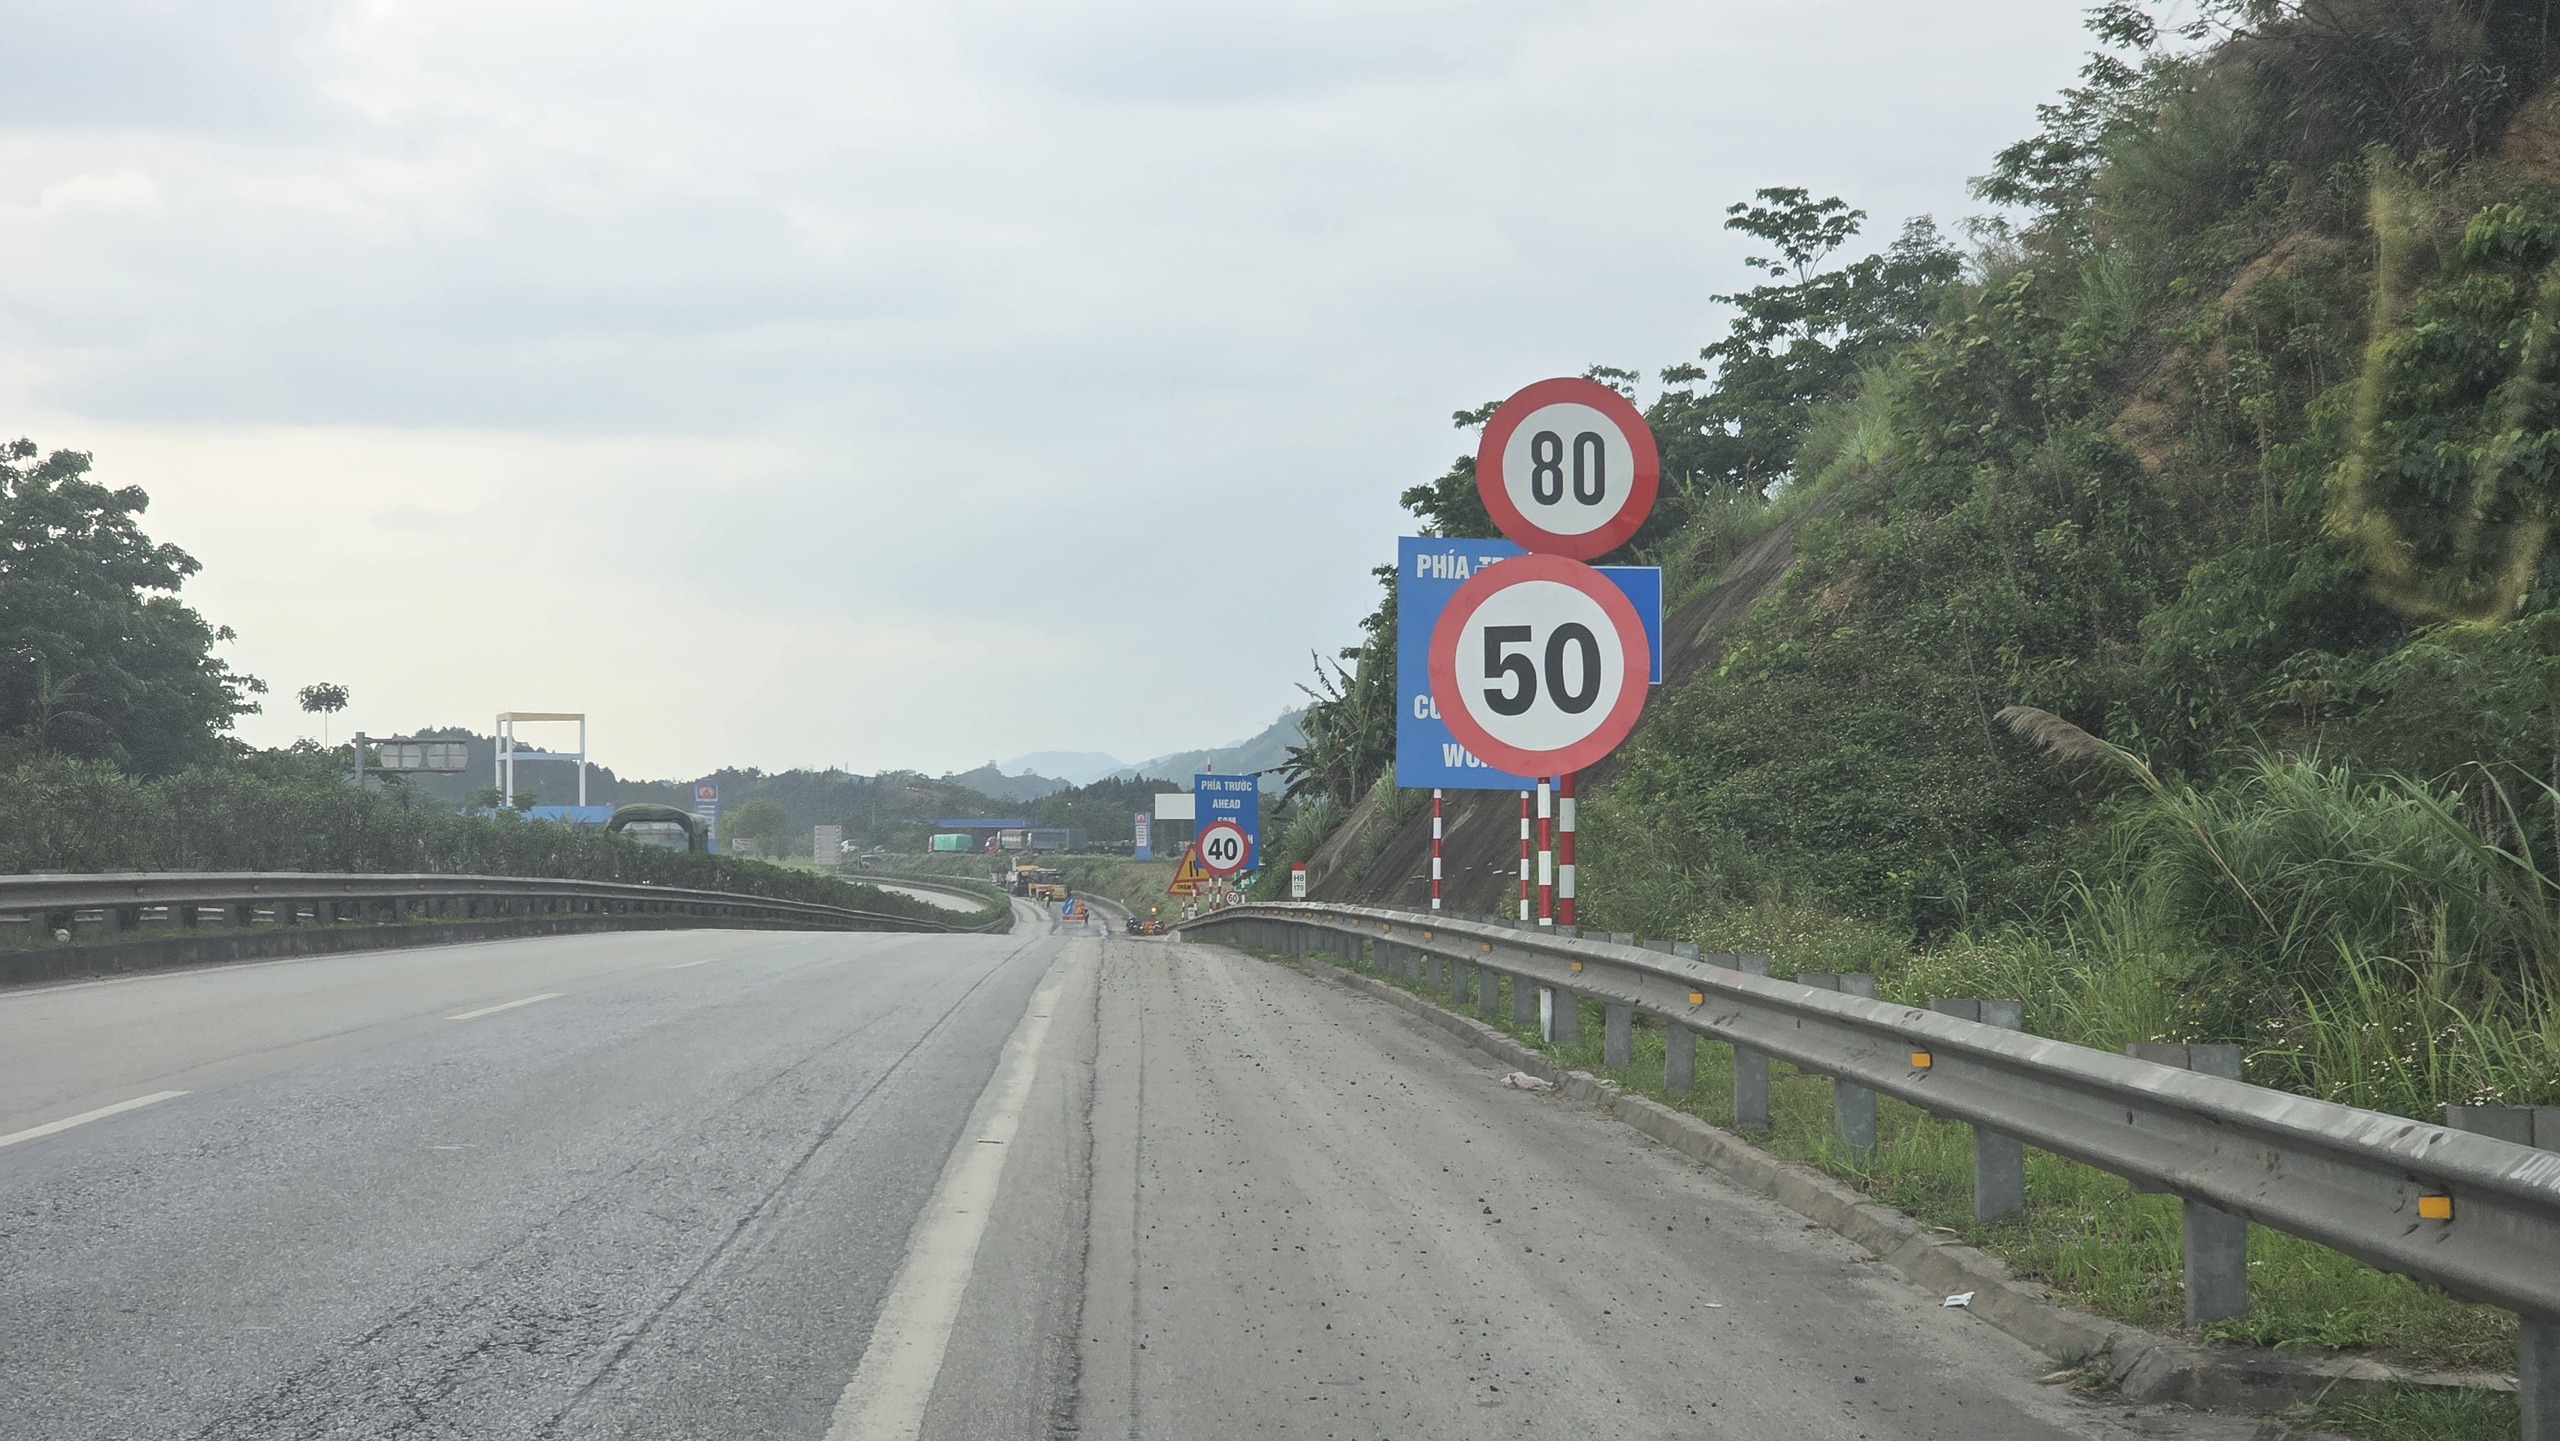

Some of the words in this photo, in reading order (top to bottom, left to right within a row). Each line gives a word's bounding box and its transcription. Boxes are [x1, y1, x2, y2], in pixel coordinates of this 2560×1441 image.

[1531, 430, 1605, 506] 80
[1416, 549, 1470, 580] PHÍA
[1483, 622, 1602, 716] 50
[1201, 778, 1221, 791] PHÍA
[1224, 779, 1252, 792] TRƯỚC
[1212, 798, 1241, 809] AHEAD
[1207, 837, 1238, 861] 40
[1293, 874, 1305, 882] H8
[1293, 884, 1305, 892] 170
[1228, 893, 1238, 903] 60
